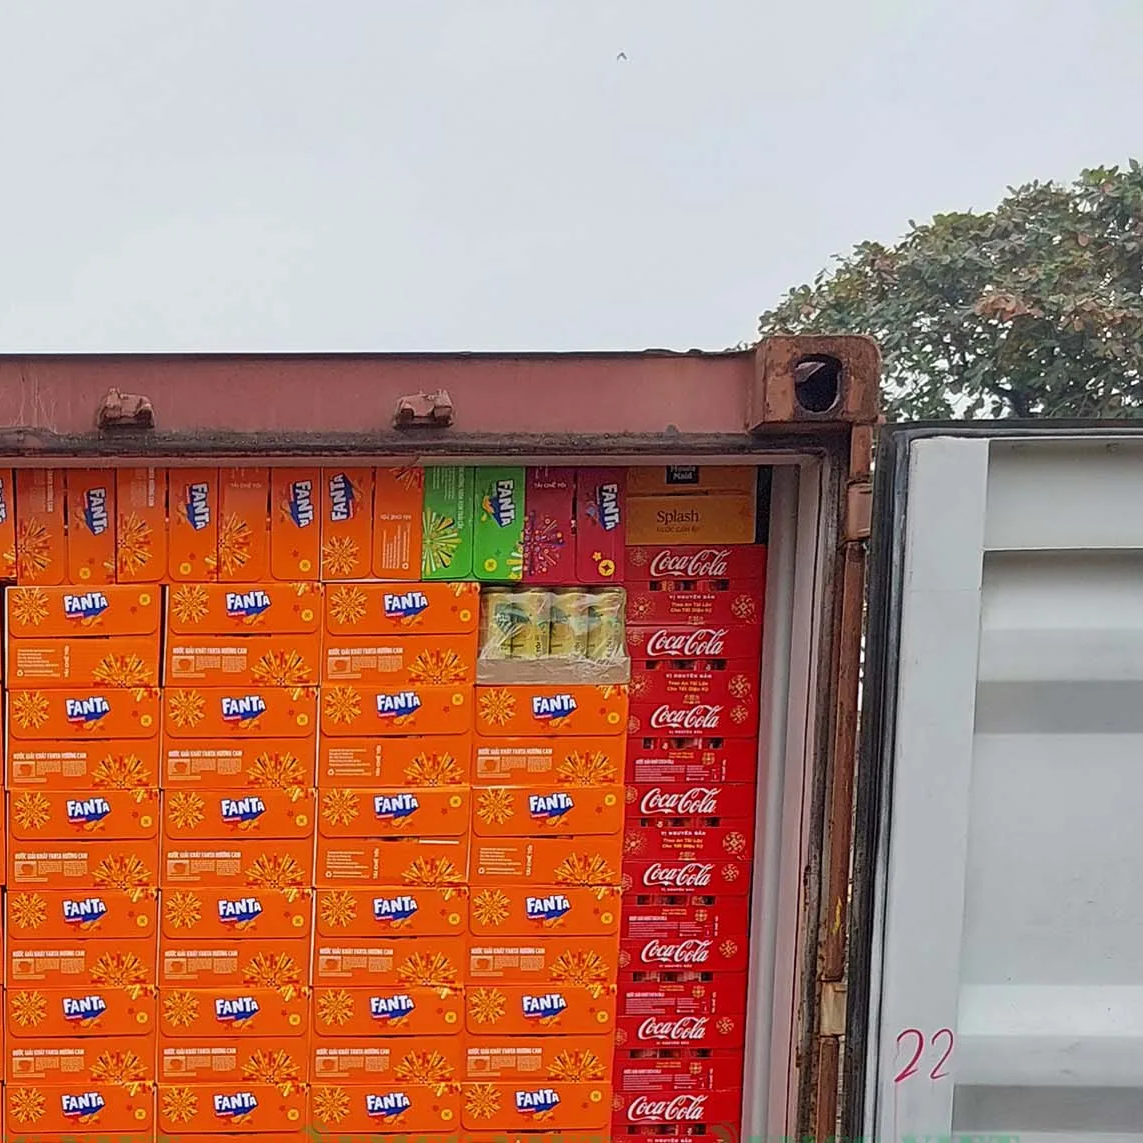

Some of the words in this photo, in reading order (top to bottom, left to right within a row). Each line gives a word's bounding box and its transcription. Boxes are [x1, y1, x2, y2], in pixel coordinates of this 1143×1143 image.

[192, 483, 210, 530] FANTA
[330, 474, 348, 521] FANTA
[498, 479, 516, 527] FANTA
[602, 484, 620, 530] FANTA
[657, 509, 699, 525] Splash
[650, 549, 731, 577] Coca-Cola
[64, 592, 109, 612] FANTA
[647, 628, 729, 656] Coca-Cola
[222, 696, 267, 715] FANTA
[650, 704, 723, 728] Coca-Cola
[374, 794, 419, 813] FANTA
[640, 787, 721, 814] Coca-Cola
[643, 862, 715, 886] Coca-Cola
[63, 899, 108, 917] FANTA
[526, 895, 571, 913] FANTA
[640, 939, 714, 963] Coca-Cola
[216, 997, 261, 1015] FANTA
[638, 1016, 710, 1040] Coca-Cola
[894, 1028, 954, 1083] 22
[367, 1093, 412, 1111] FANTA
[627, 1094, 709, 1121] Coca-Cola
